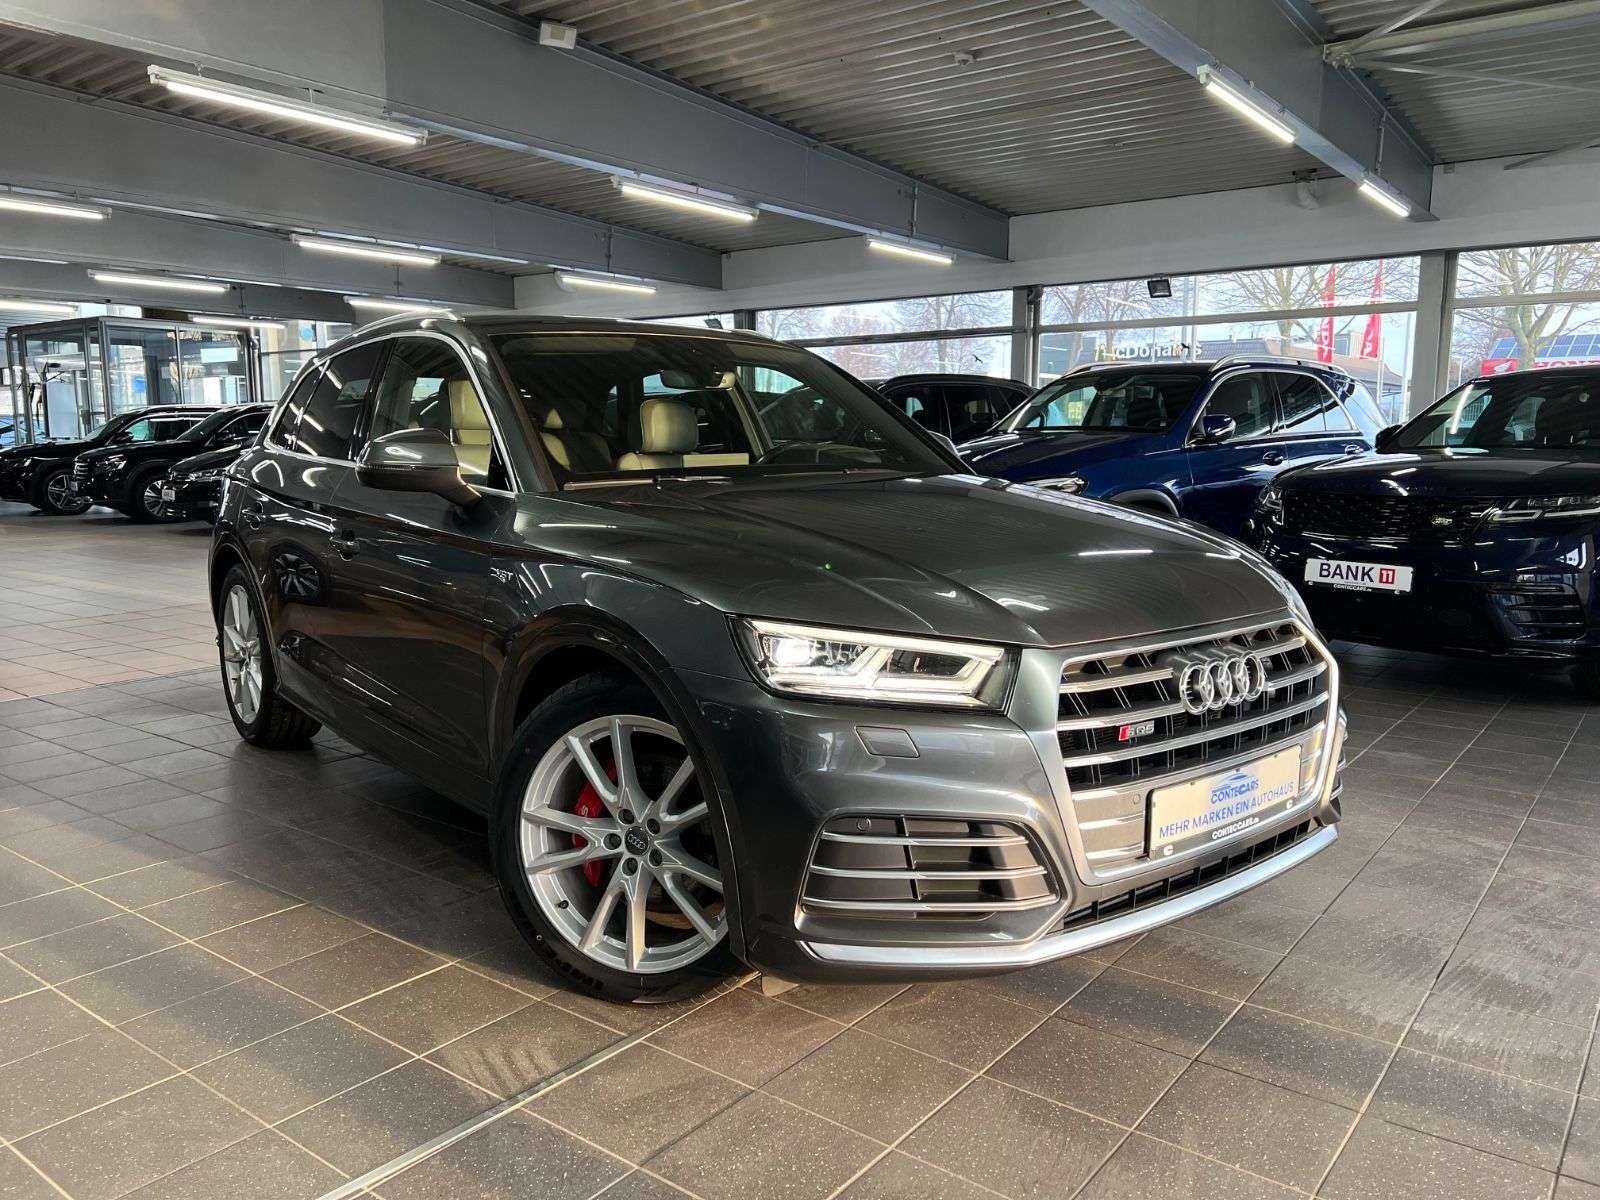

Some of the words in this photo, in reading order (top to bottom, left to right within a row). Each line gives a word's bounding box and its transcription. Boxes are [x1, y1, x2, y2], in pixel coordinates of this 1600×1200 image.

[1319, 563, 1374, 583] BANK
[1380, 569, 1394, 583] 11
[1160, 819, 1189, 838] MEHR
[1192, 805, 1234, 828] MARKEN
[1235, 798, 1249, 814] EIN
[1250, 782, 1294, 806] AUTOHAUS
